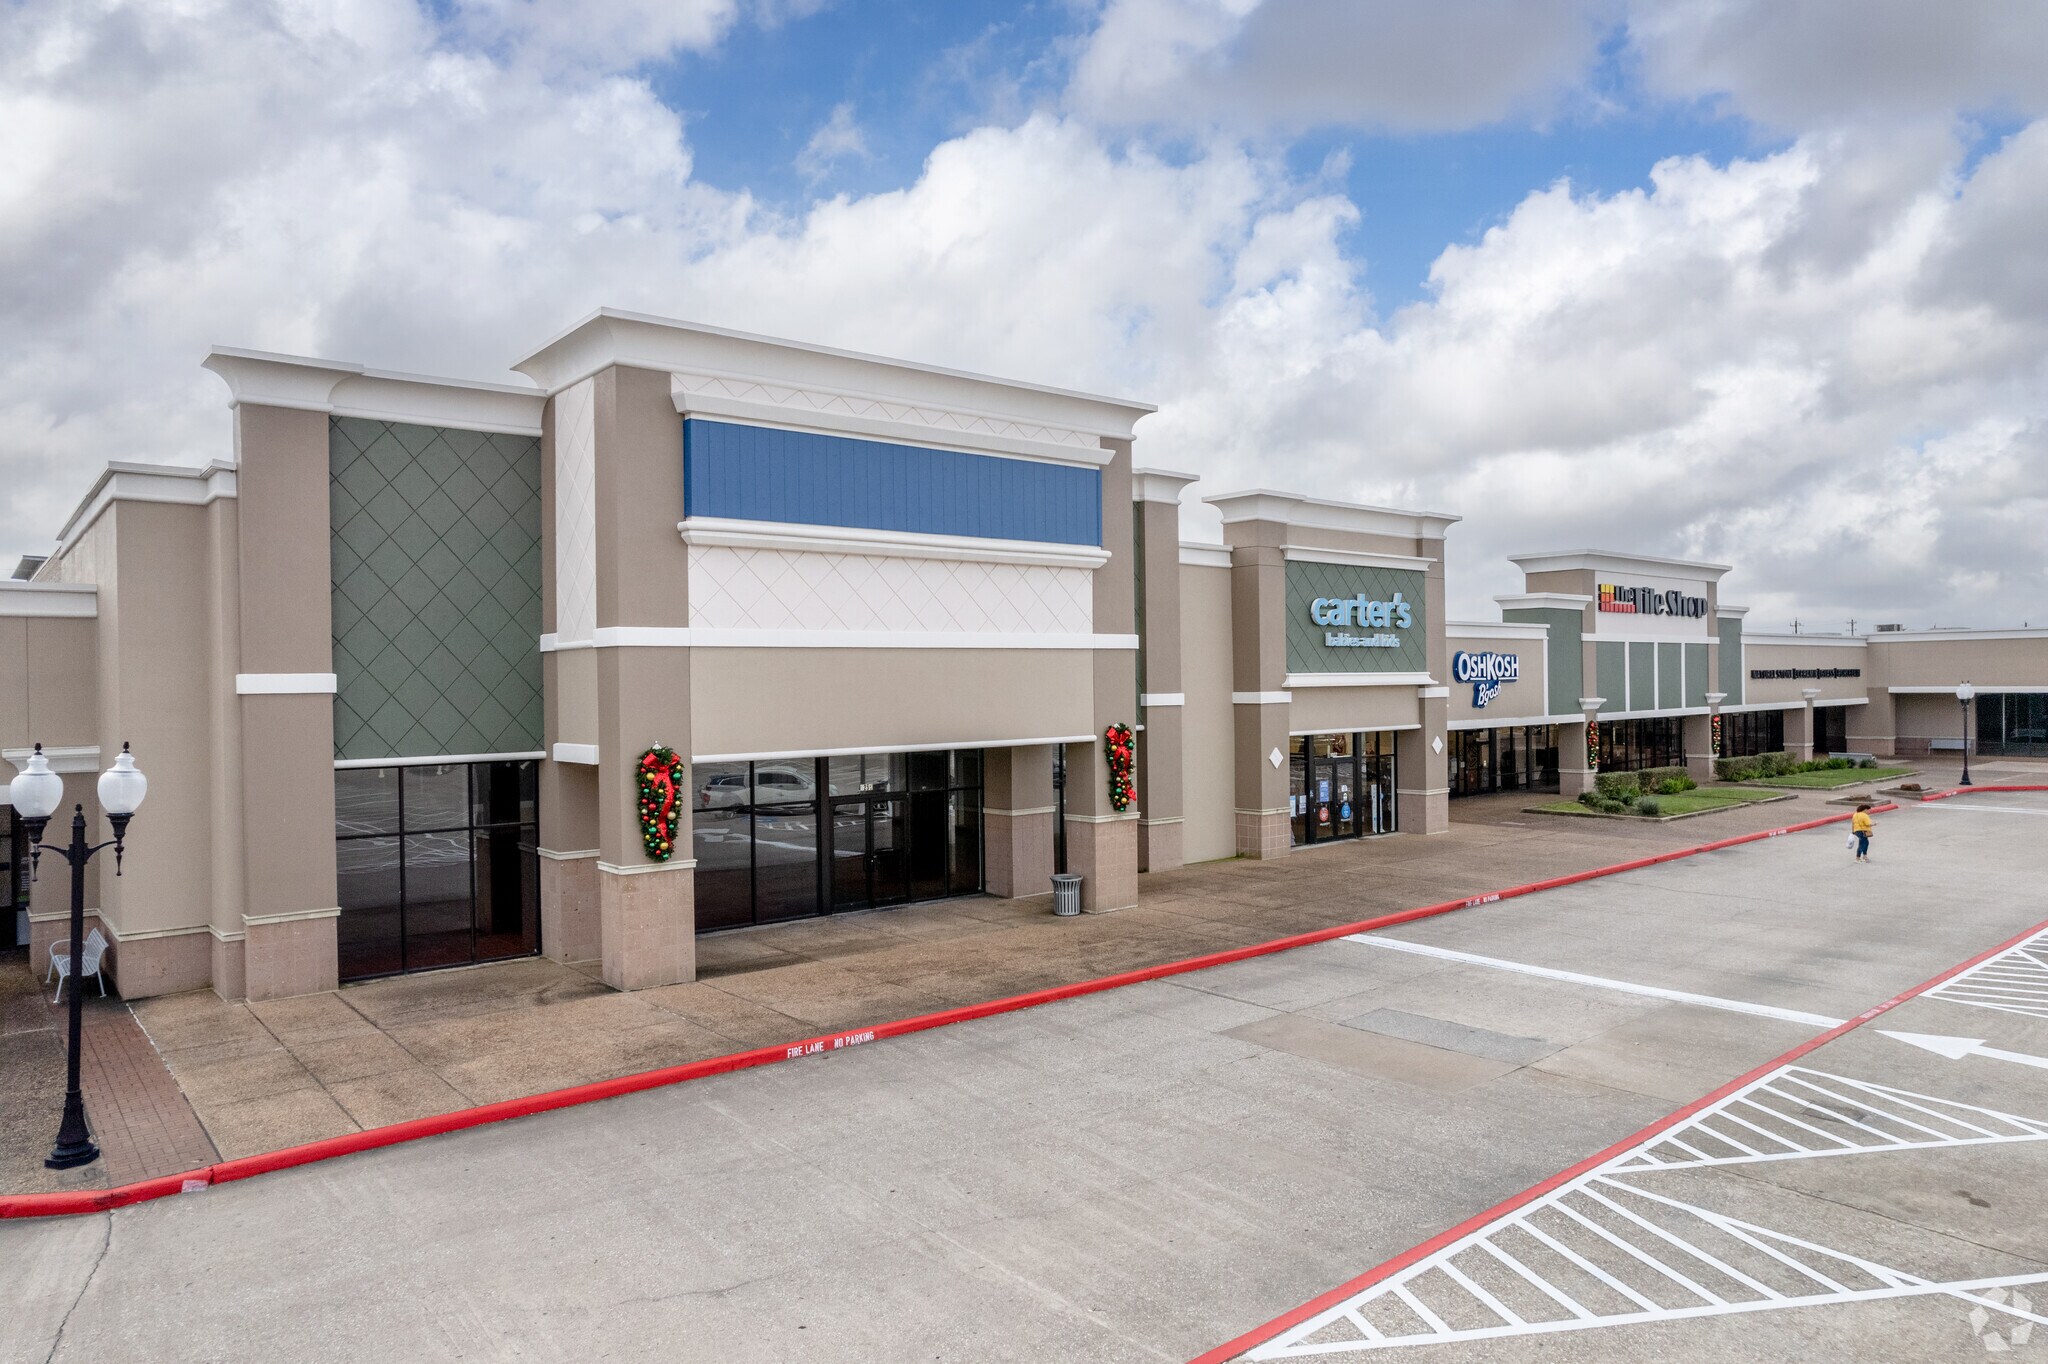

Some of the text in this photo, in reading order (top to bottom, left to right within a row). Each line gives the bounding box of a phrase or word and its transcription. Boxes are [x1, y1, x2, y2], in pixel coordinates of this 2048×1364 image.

[1311, 592, 1411, 629] carter's
[1615, 585, 1708, 619] The Tile Shop
[787, 1031, 875, 1059] FIRE LANE NO PARKING
